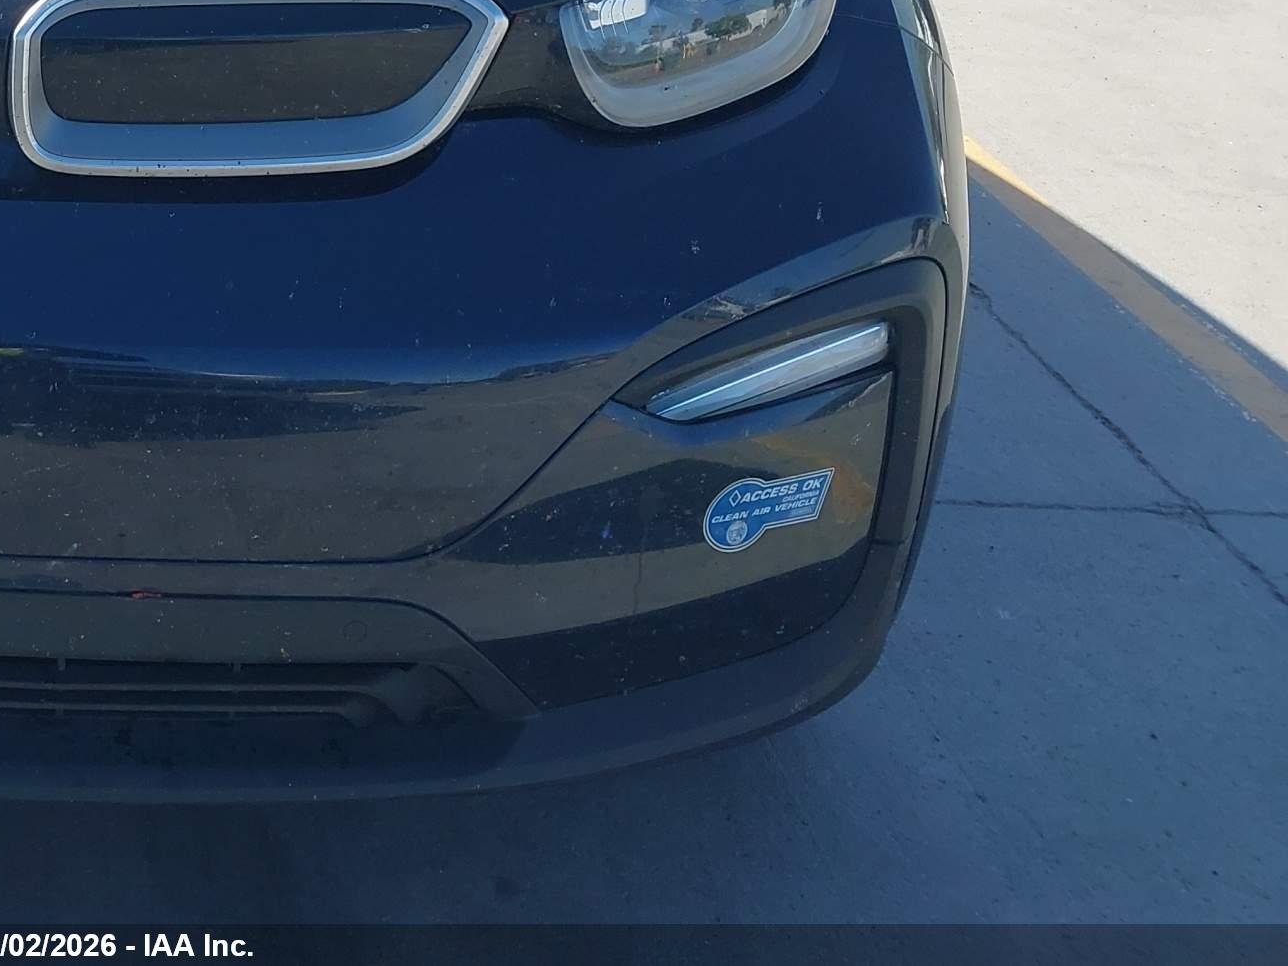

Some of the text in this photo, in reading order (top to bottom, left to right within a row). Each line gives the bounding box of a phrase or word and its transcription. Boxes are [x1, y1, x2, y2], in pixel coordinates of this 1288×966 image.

[740, 477, 825, 504] ACCESS OK
[781, 489, 820, 503] CALIFORNIA
[711, 509, 749, 524] CLEAN
[751, 506, 772, 517] AIR
[775, 497, 818, 513] VEHICLE
